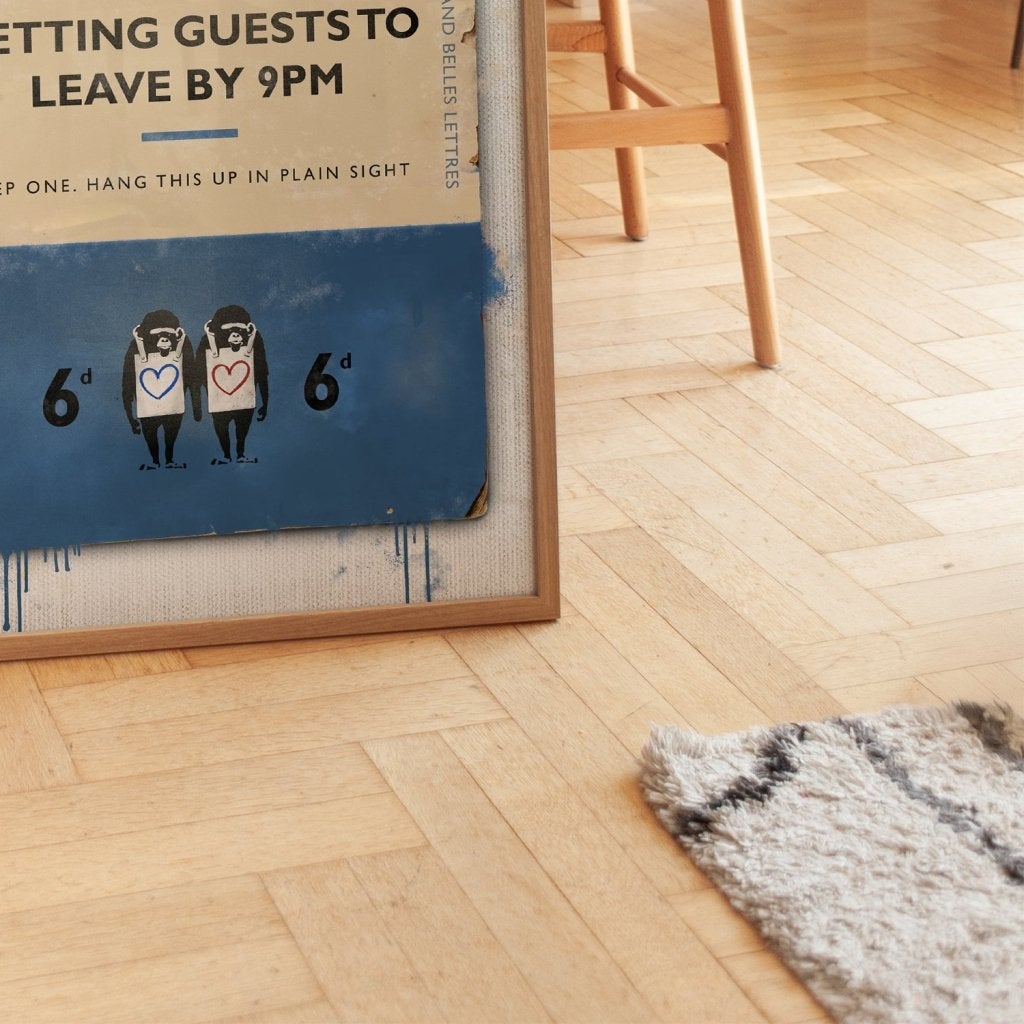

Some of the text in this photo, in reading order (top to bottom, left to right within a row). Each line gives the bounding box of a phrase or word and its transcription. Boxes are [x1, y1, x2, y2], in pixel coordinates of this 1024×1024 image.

[174, 9, 350, 47] GUESTS
[357, 7, 419, 39] TO
[32, 63, 343, 107] LEAVE BY 9PM
[443, 43, 457, 104] BELLES
[444, 112, 459, 189] LETTRES
[27, 179, 76, 194] ONE.
[88, 176, 146, 191] HANG
[156, 173, 201, 187] THIS
[213, 171, 237, 185] UP
[249, 170, 268, 183] IN
[281, 166, 338, 182] PLAIN
[350, 163, 409, 178] SIGHT
